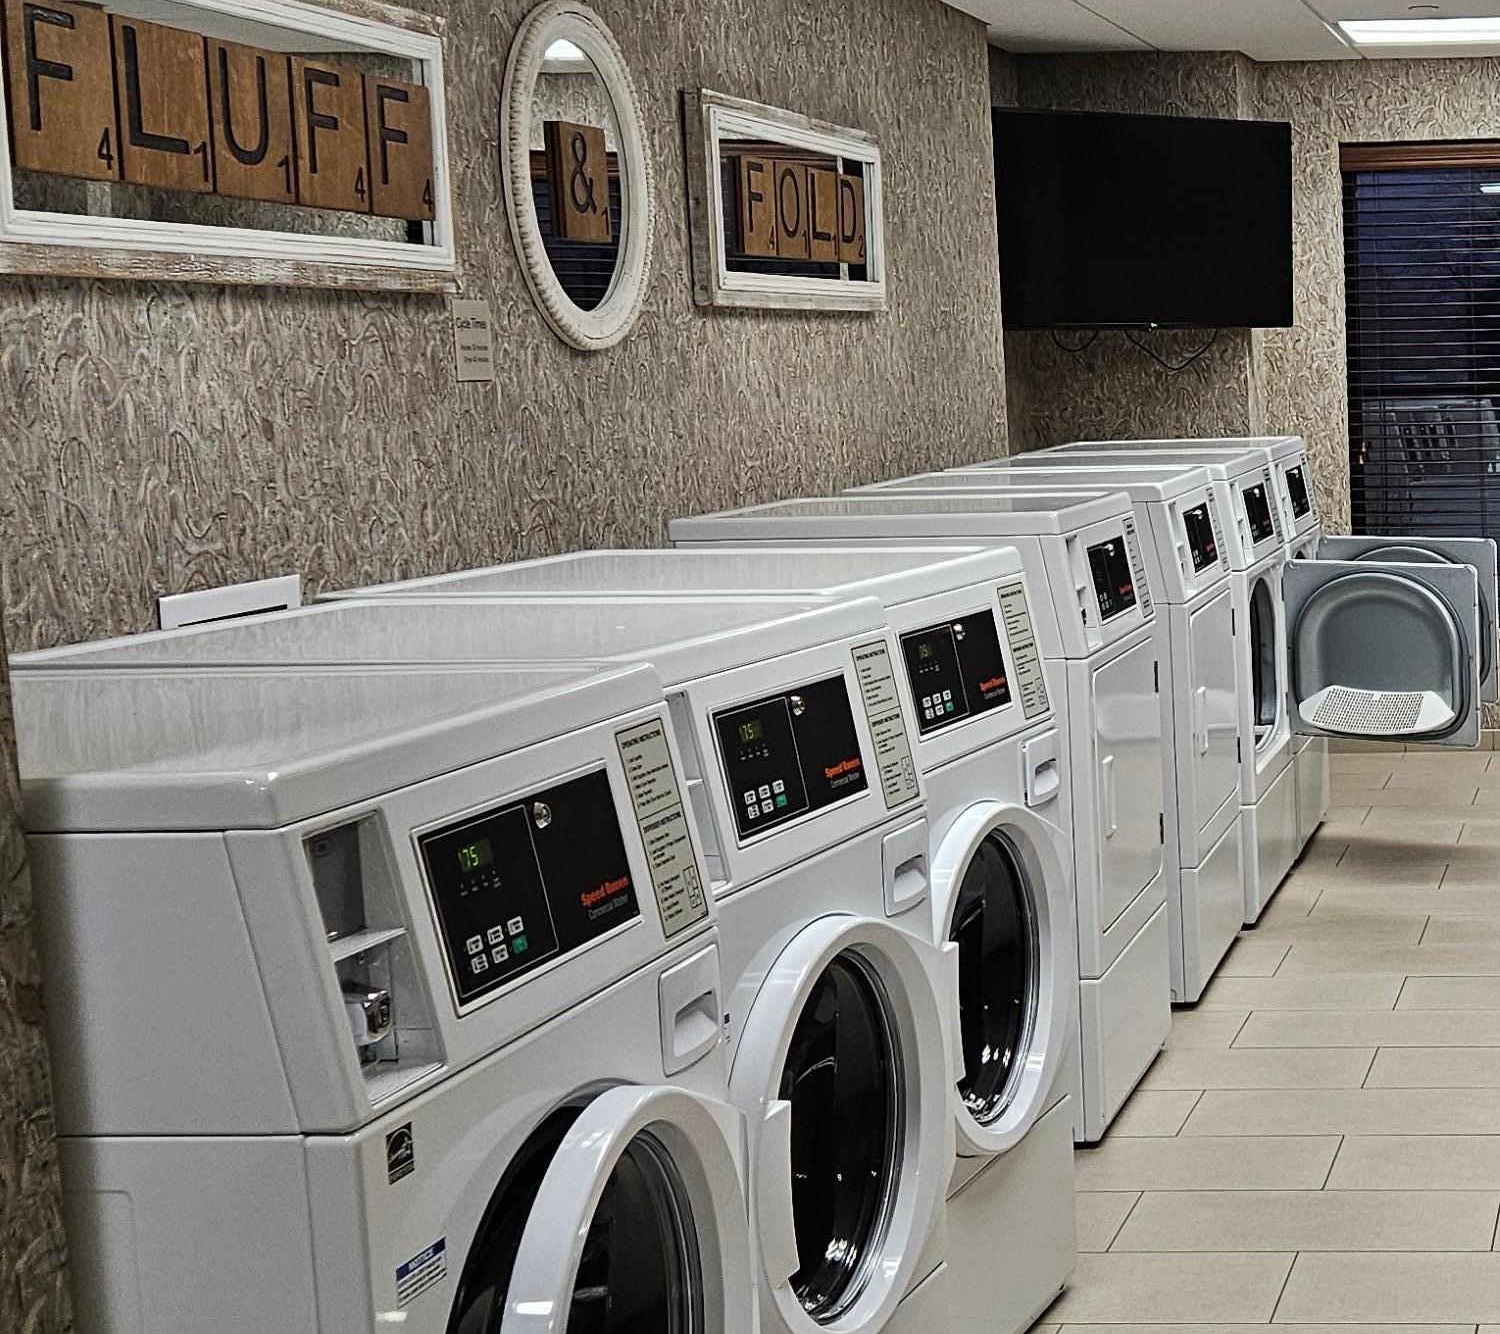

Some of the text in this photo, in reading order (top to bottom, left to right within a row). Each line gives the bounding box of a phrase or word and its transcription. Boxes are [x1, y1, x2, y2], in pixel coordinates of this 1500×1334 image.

[23, 3, 410, 186] FLUFF
[97, 126, 435, 211] 4 1 1 4 4
[569, 130, 598, 215] &
[745, 160, 858, 245] FOLD
[600, 209, 611, 235] 1
[766, 224, 865, 259] 4 1 1 2
[462, 845, 479, 868] 75
[580, 876, 630, 908] Speed Queen
[408, 1246, 435, 1273] NOTICE
